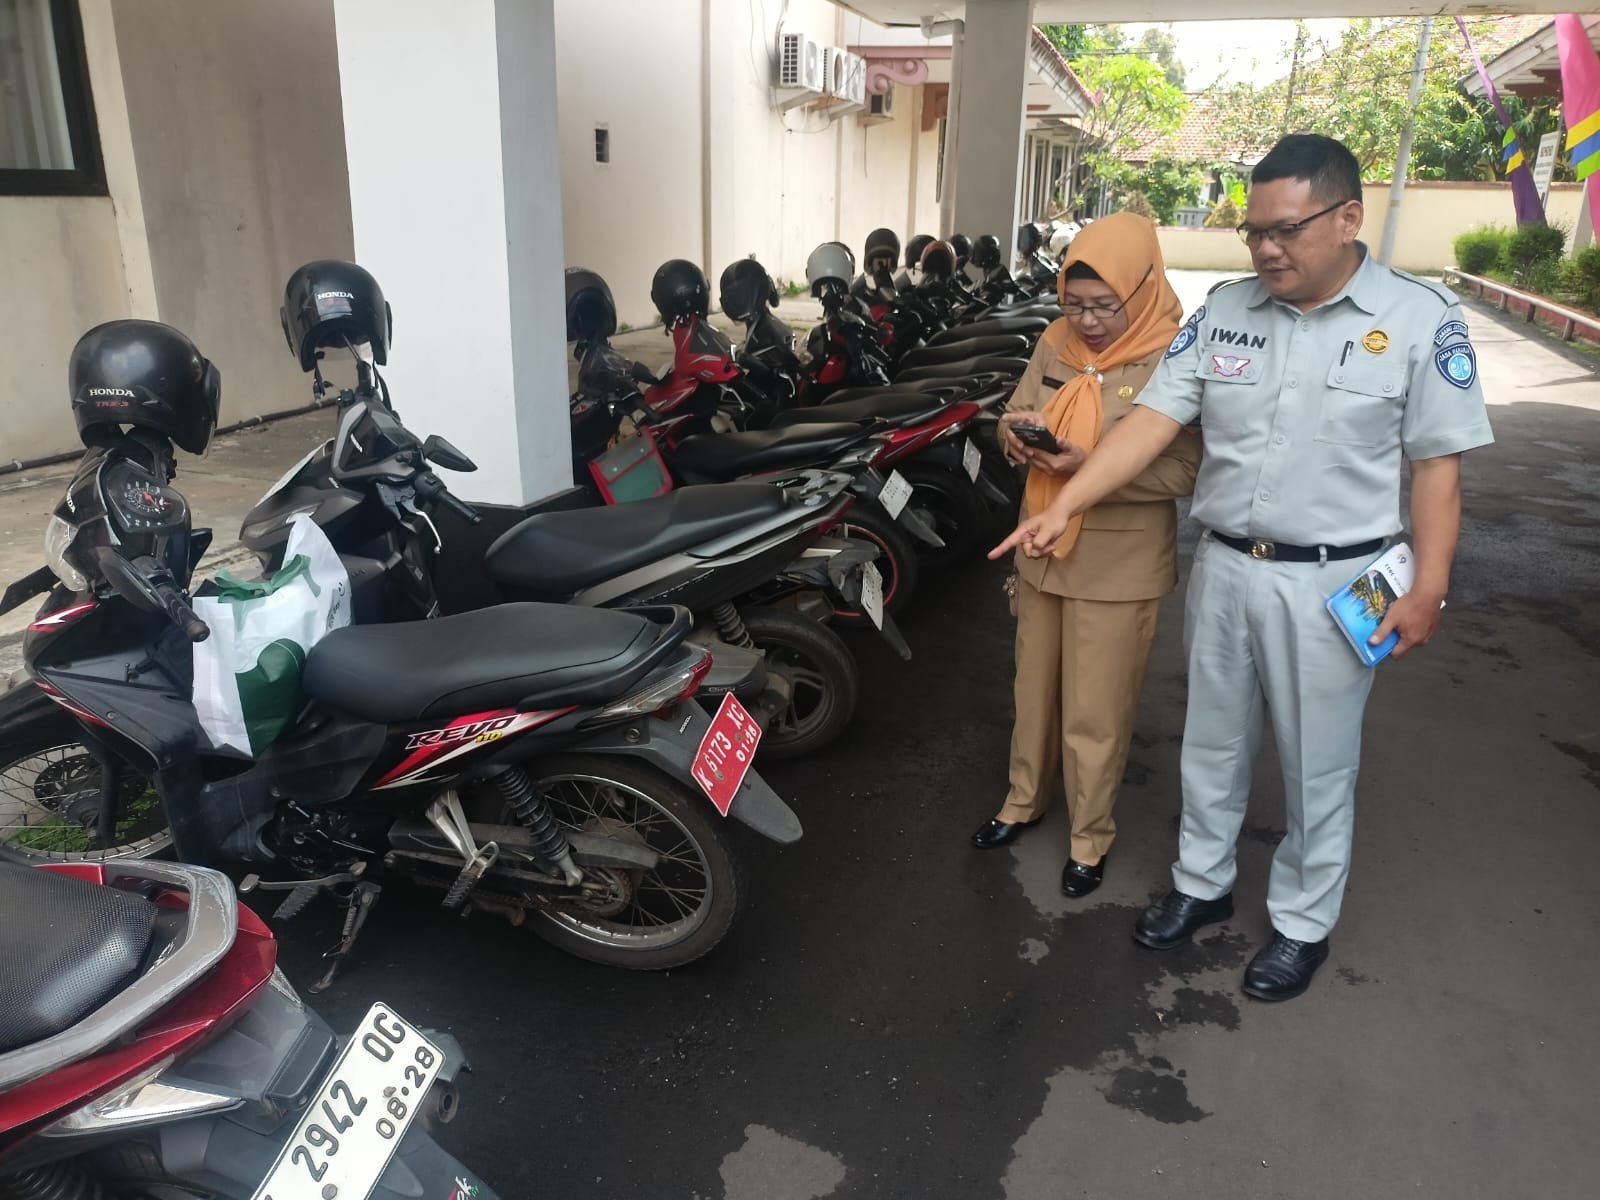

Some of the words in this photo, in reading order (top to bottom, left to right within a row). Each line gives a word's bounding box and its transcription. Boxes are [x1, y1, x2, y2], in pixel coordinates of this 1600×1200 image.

[317, 291, 354, 300] HONDA
[1210, 327, 1266, 349] IWAN
[89, 388, 136, 398] HONDA
[405, 714, 521, 750] REVO
[697, 768, 714, 792] K
[726, 703, 745, 730] XC
[291, 1079, 367, 1182] 2942
